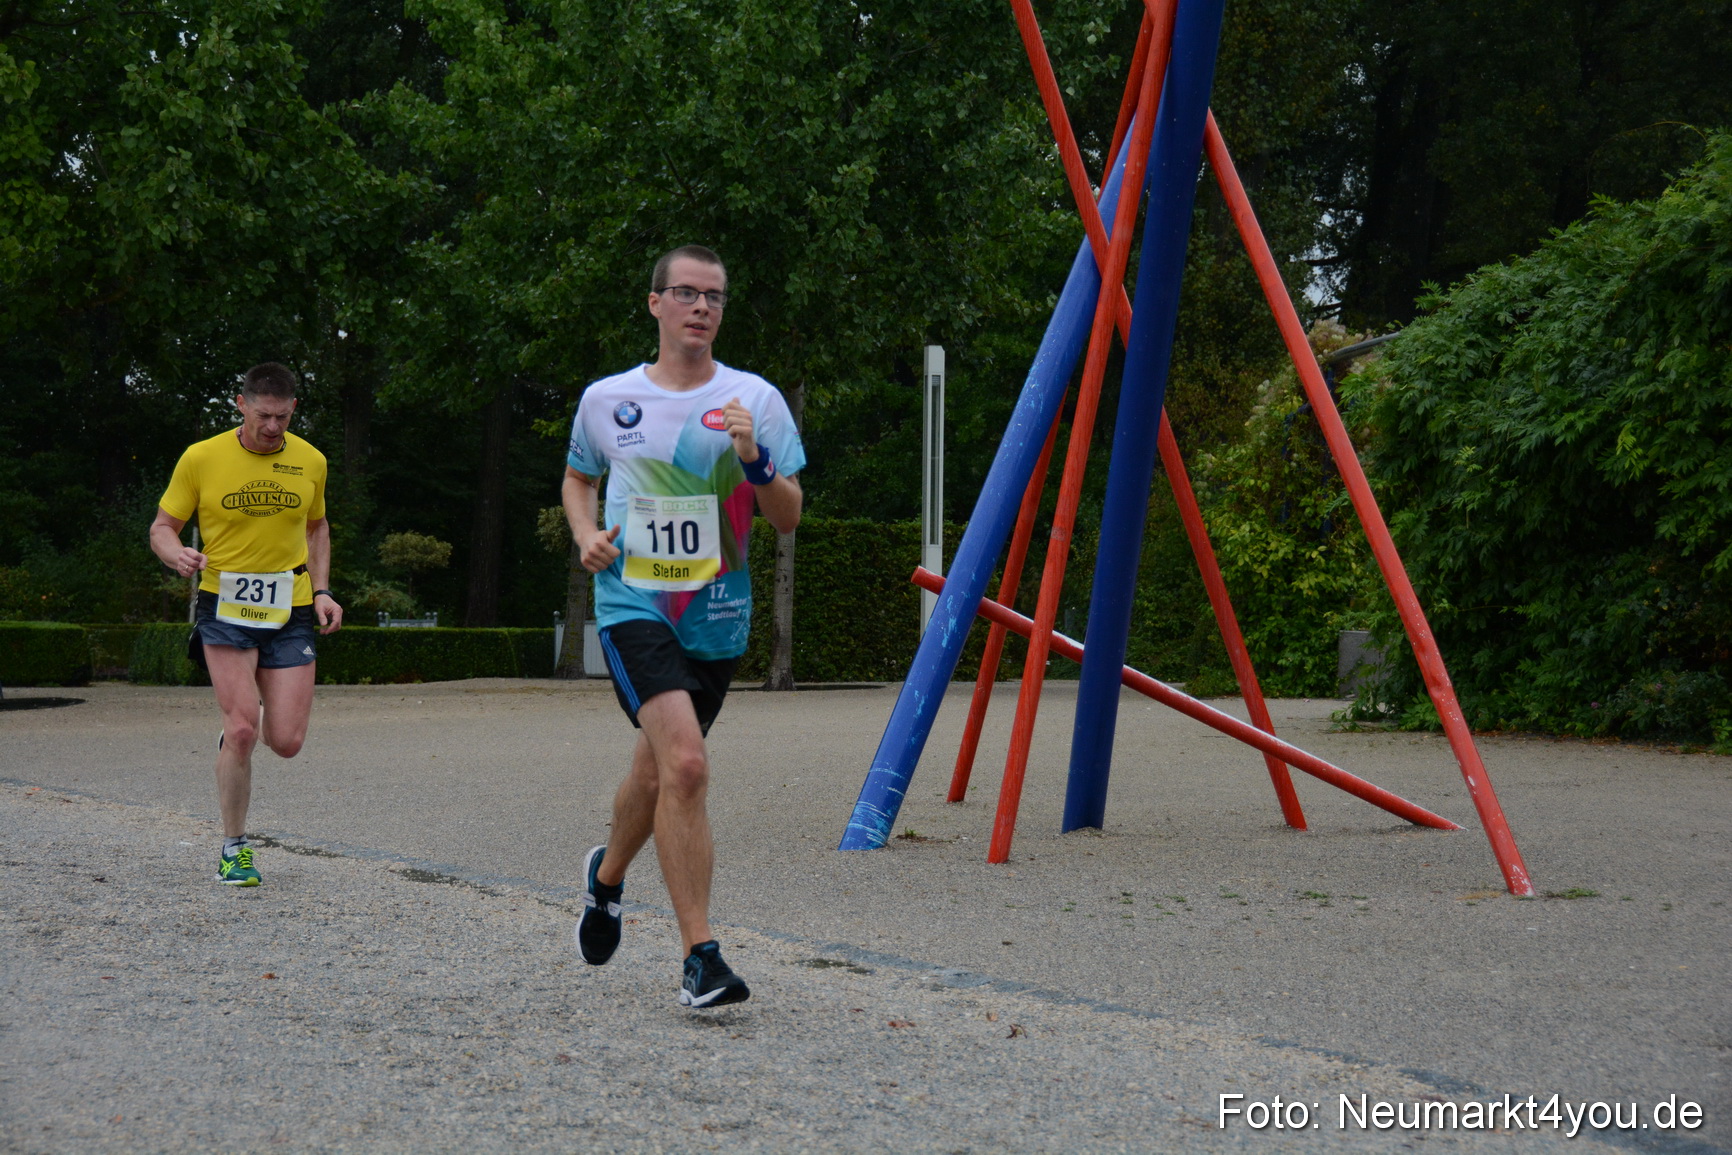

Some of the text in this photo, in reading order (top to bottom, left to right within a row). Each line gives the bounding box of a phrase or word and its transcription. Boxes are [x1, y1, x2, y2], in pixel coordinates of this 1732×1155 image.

[617, 432, 645, 442] PARTL
[618, 439, 645, 448] Neumarkt
[240, 481, 284, 493] PIZZERIA
[231, 493, 292, 506] FRANCESCO
[662, 500, 708, 511] BOCK
[647, 520, 699, 554] 110
[653, 563, 690, 578] Stefan
[235, 577, 277, 604] 231
[709, 583, 729, 599] 17.
[241, 607, 268, 619] Oliver
[707, 609, 742, 620] Stadtlauf
